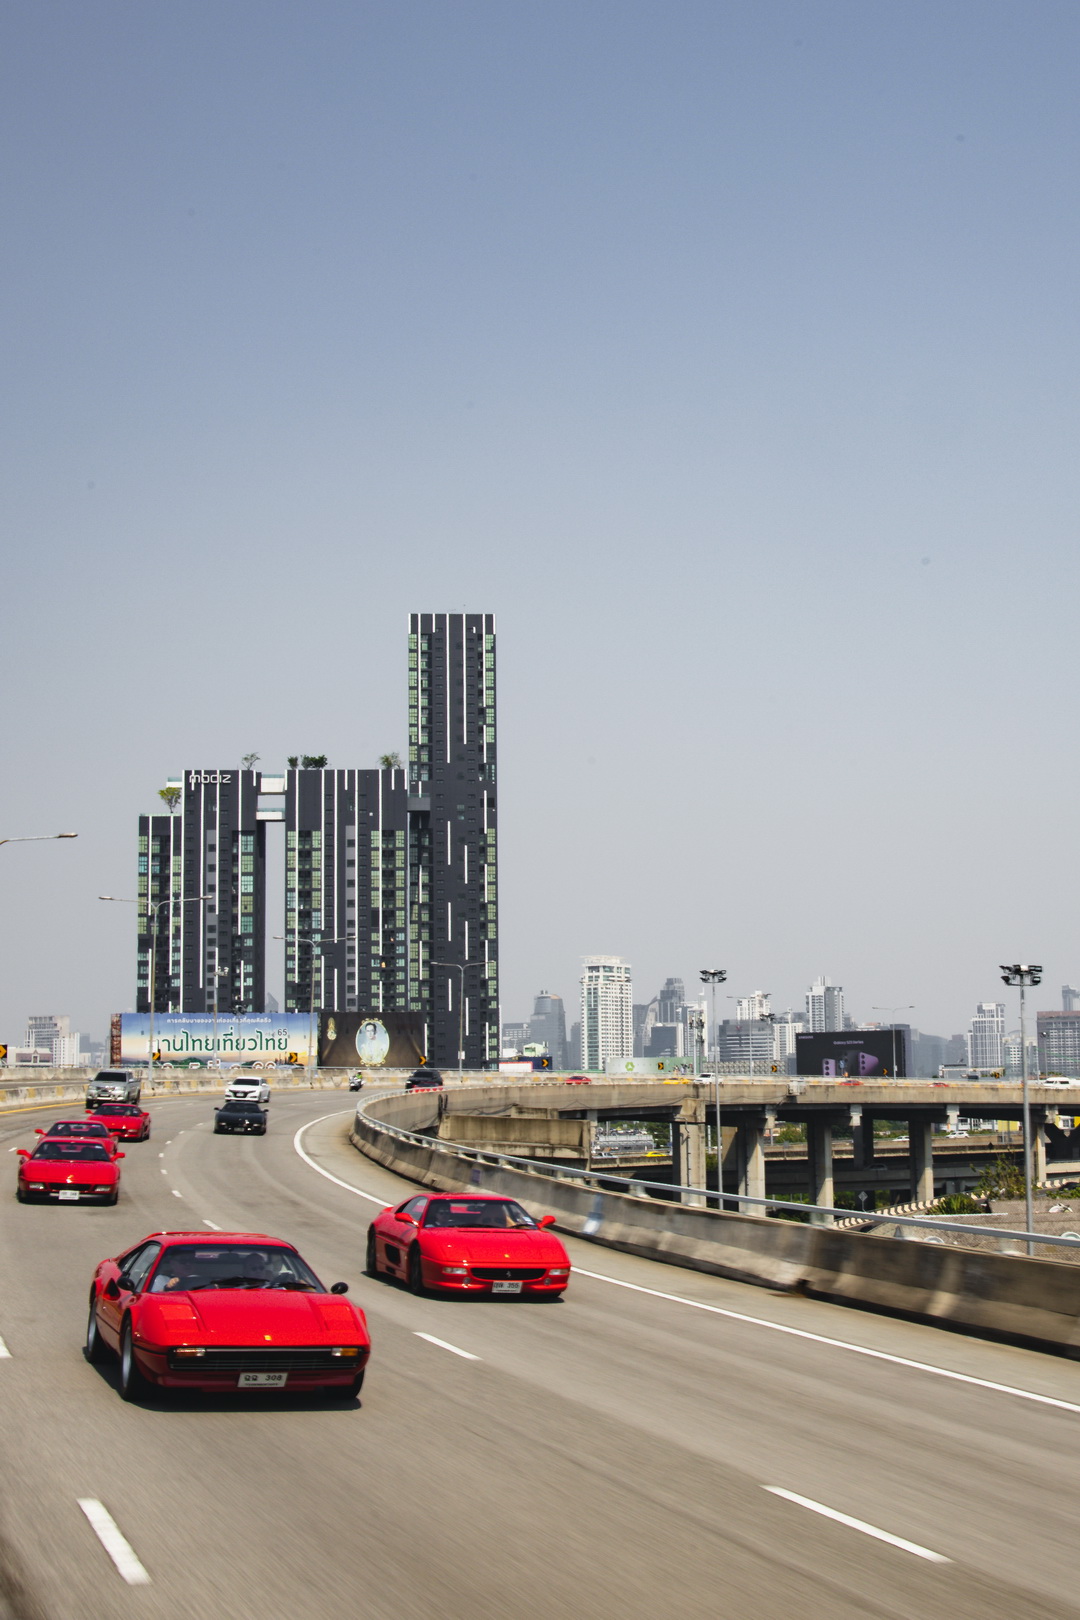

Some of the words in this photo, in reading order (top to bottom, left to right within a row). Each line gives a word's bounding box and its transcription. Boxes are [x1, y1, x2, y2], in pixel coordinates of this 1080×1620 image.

[157, 1026, 288, 1051] านไทยเที่ยวไทย
[277, 1028, 288, 1036] 65
